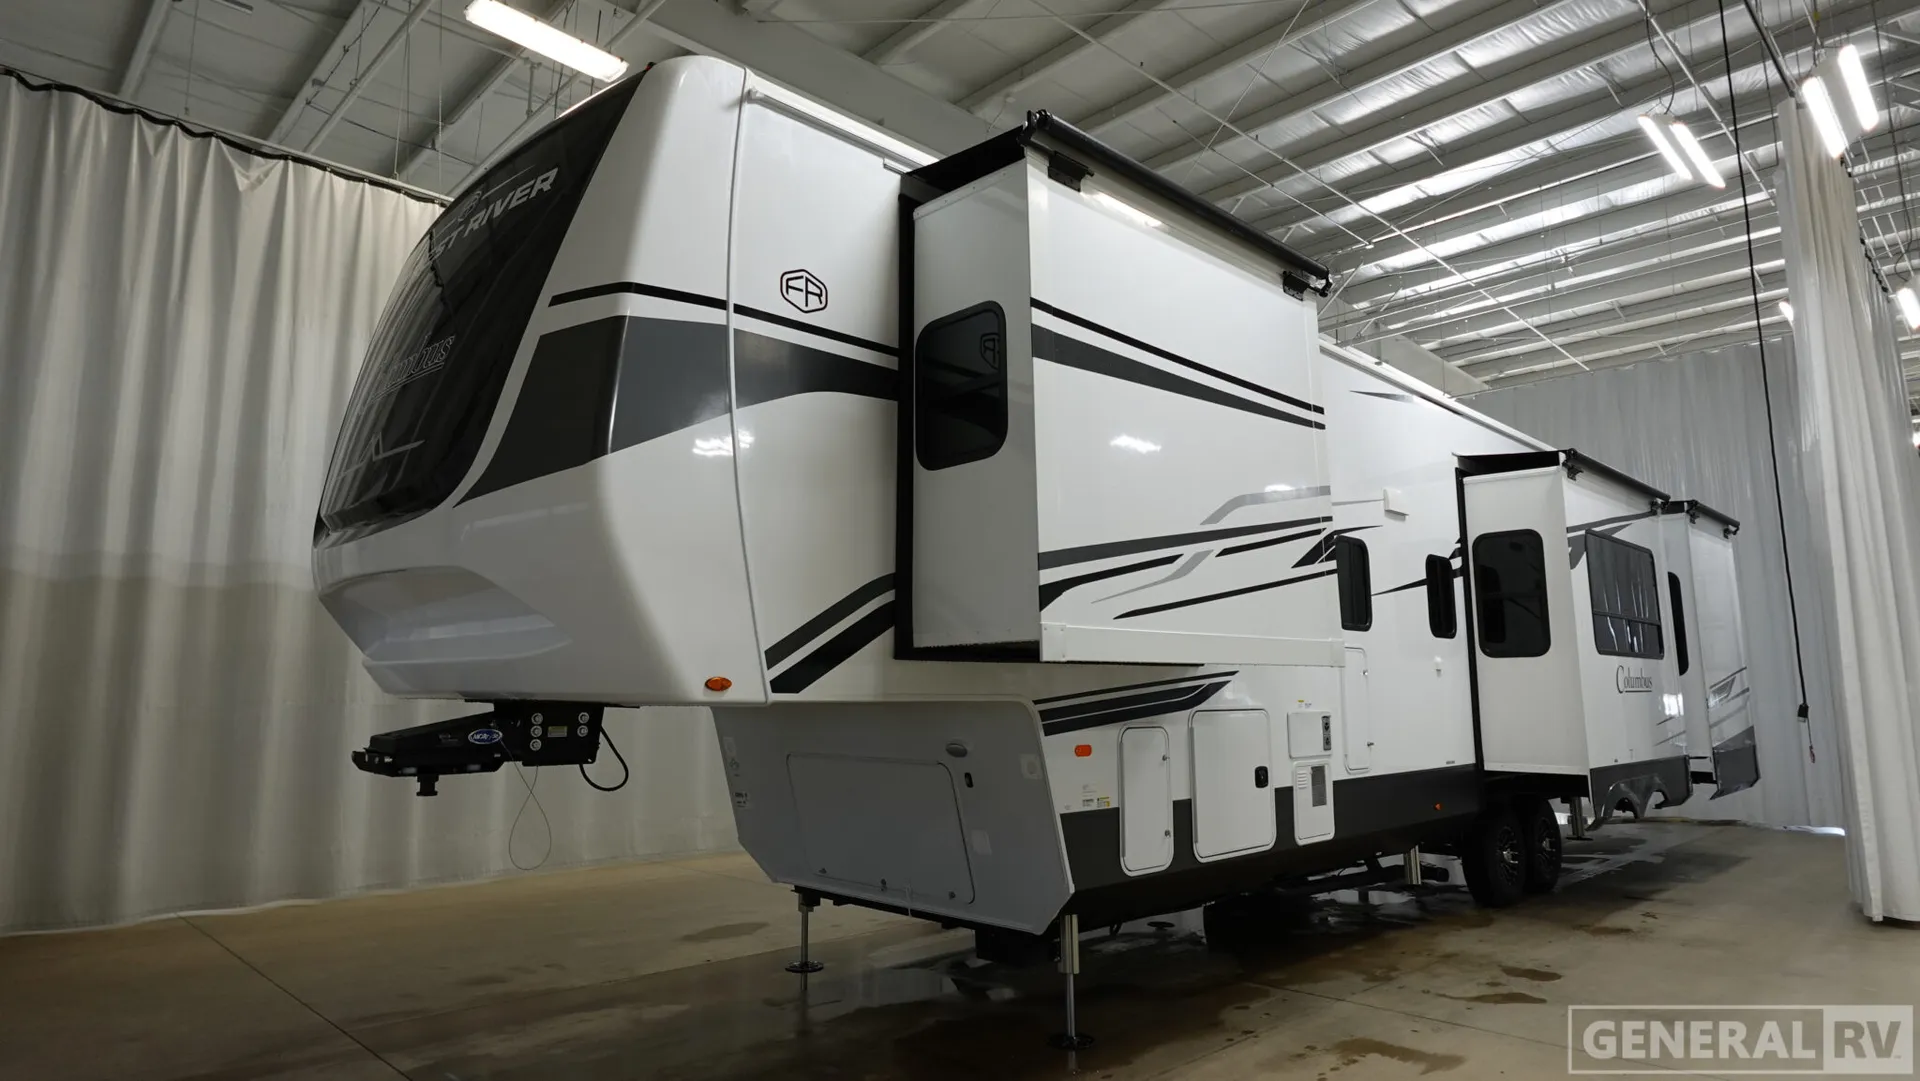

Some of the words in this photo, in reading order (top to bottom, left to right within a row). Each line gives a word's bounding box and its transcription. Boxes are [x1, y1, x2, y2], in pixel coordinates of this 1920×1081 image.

[462, 167, 559, 238] RIVER
[785, 275, 823, 307] FR
[1616, 664, 1653, 694] Columbus
